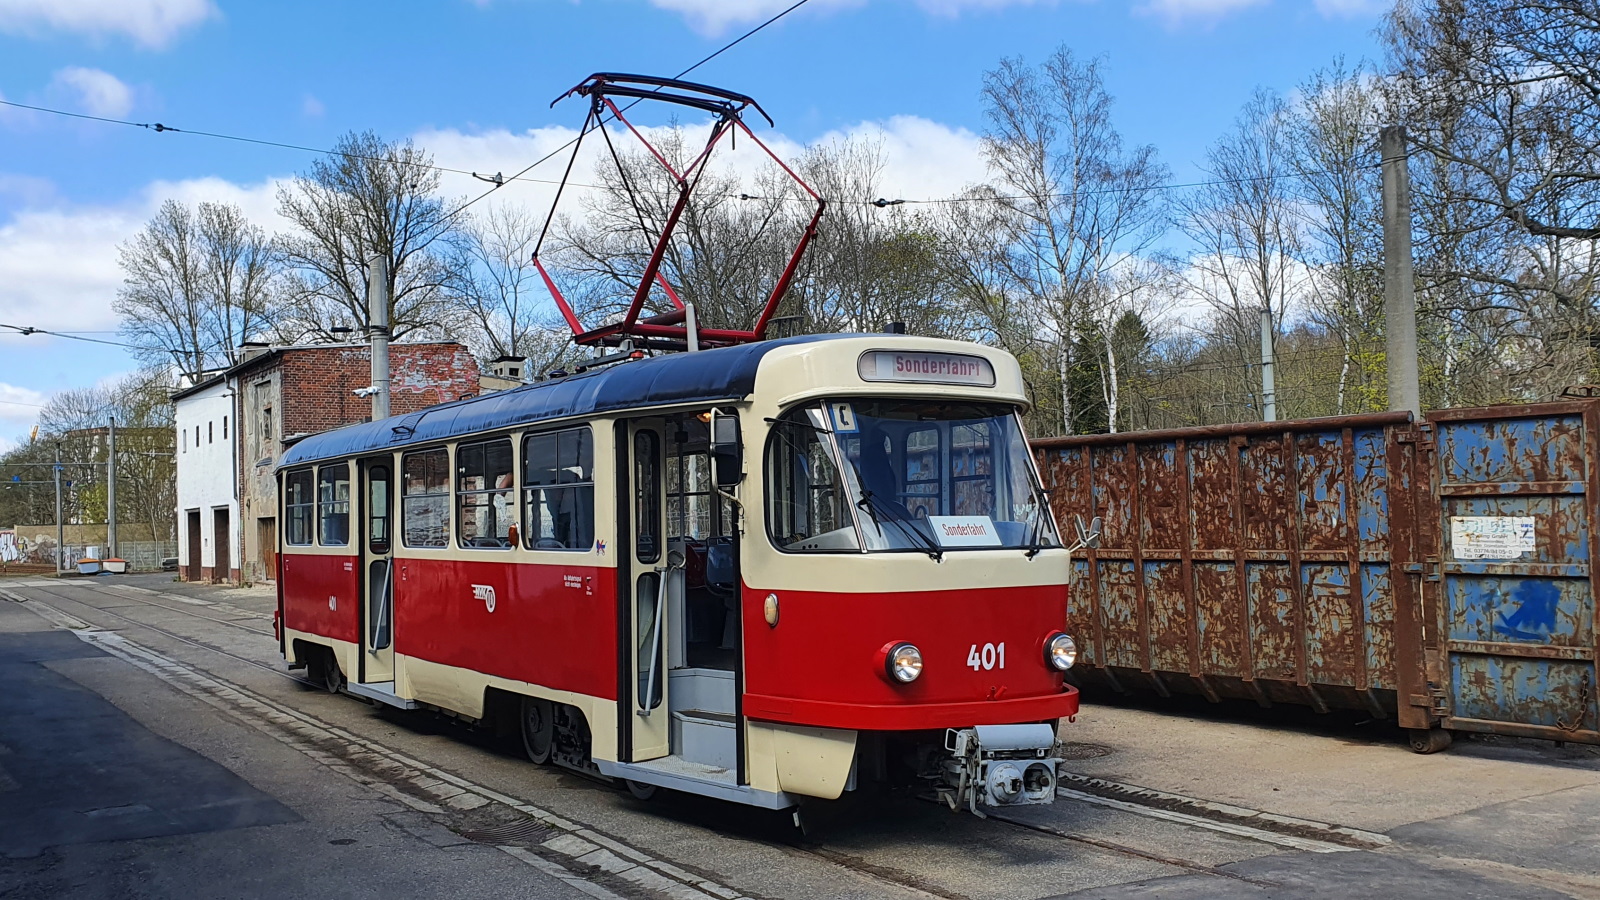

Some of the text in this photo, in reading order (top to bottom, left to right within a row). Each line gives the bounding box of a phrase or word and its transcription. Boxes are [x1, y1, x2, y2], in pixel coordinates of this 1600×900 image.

[896, 356, 981, 376] Sonderfahrt
[942, 523, 987, 536] Sonderfahrt
[328, 595, 337, 612] 401
[967, 642, 1005, 671] 401
